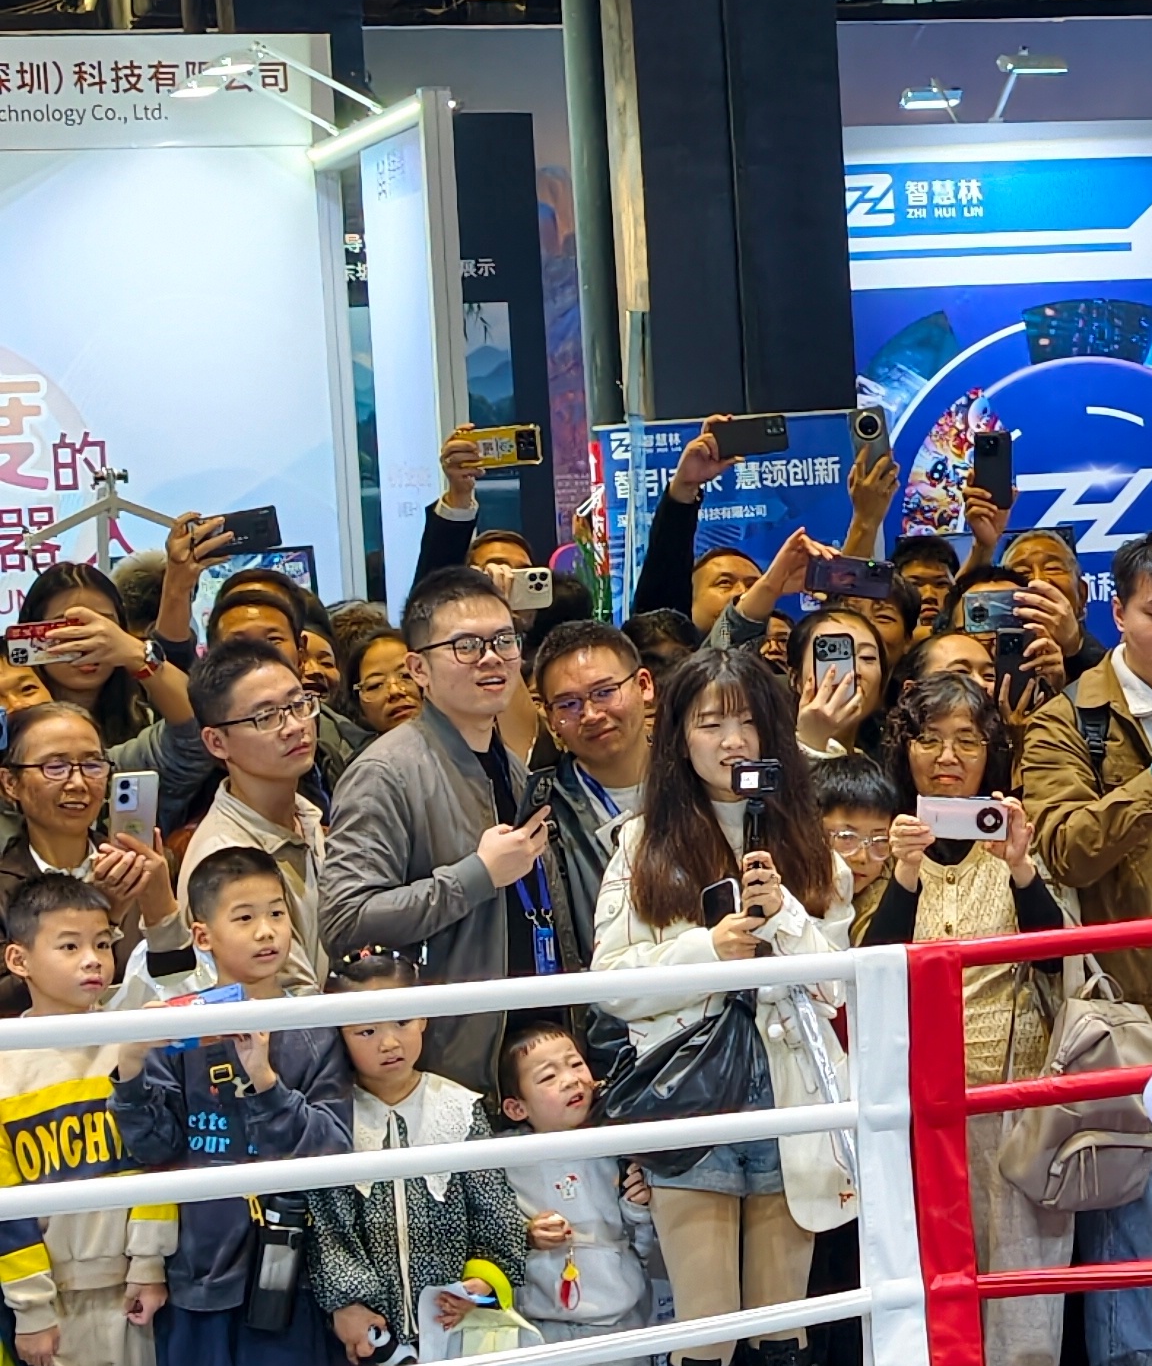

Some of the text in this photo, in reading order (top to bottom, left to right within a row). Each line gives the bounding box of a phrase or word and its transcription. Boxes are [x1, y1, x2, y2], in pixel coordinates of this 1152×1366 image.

[133, 103, 169, 121] Ltd.
[905, 178, 983, 206] 智慧林
[906, 206, 984, 219] ZHI HUI LIN
[734, 456, 841, 490] 慧领创新
